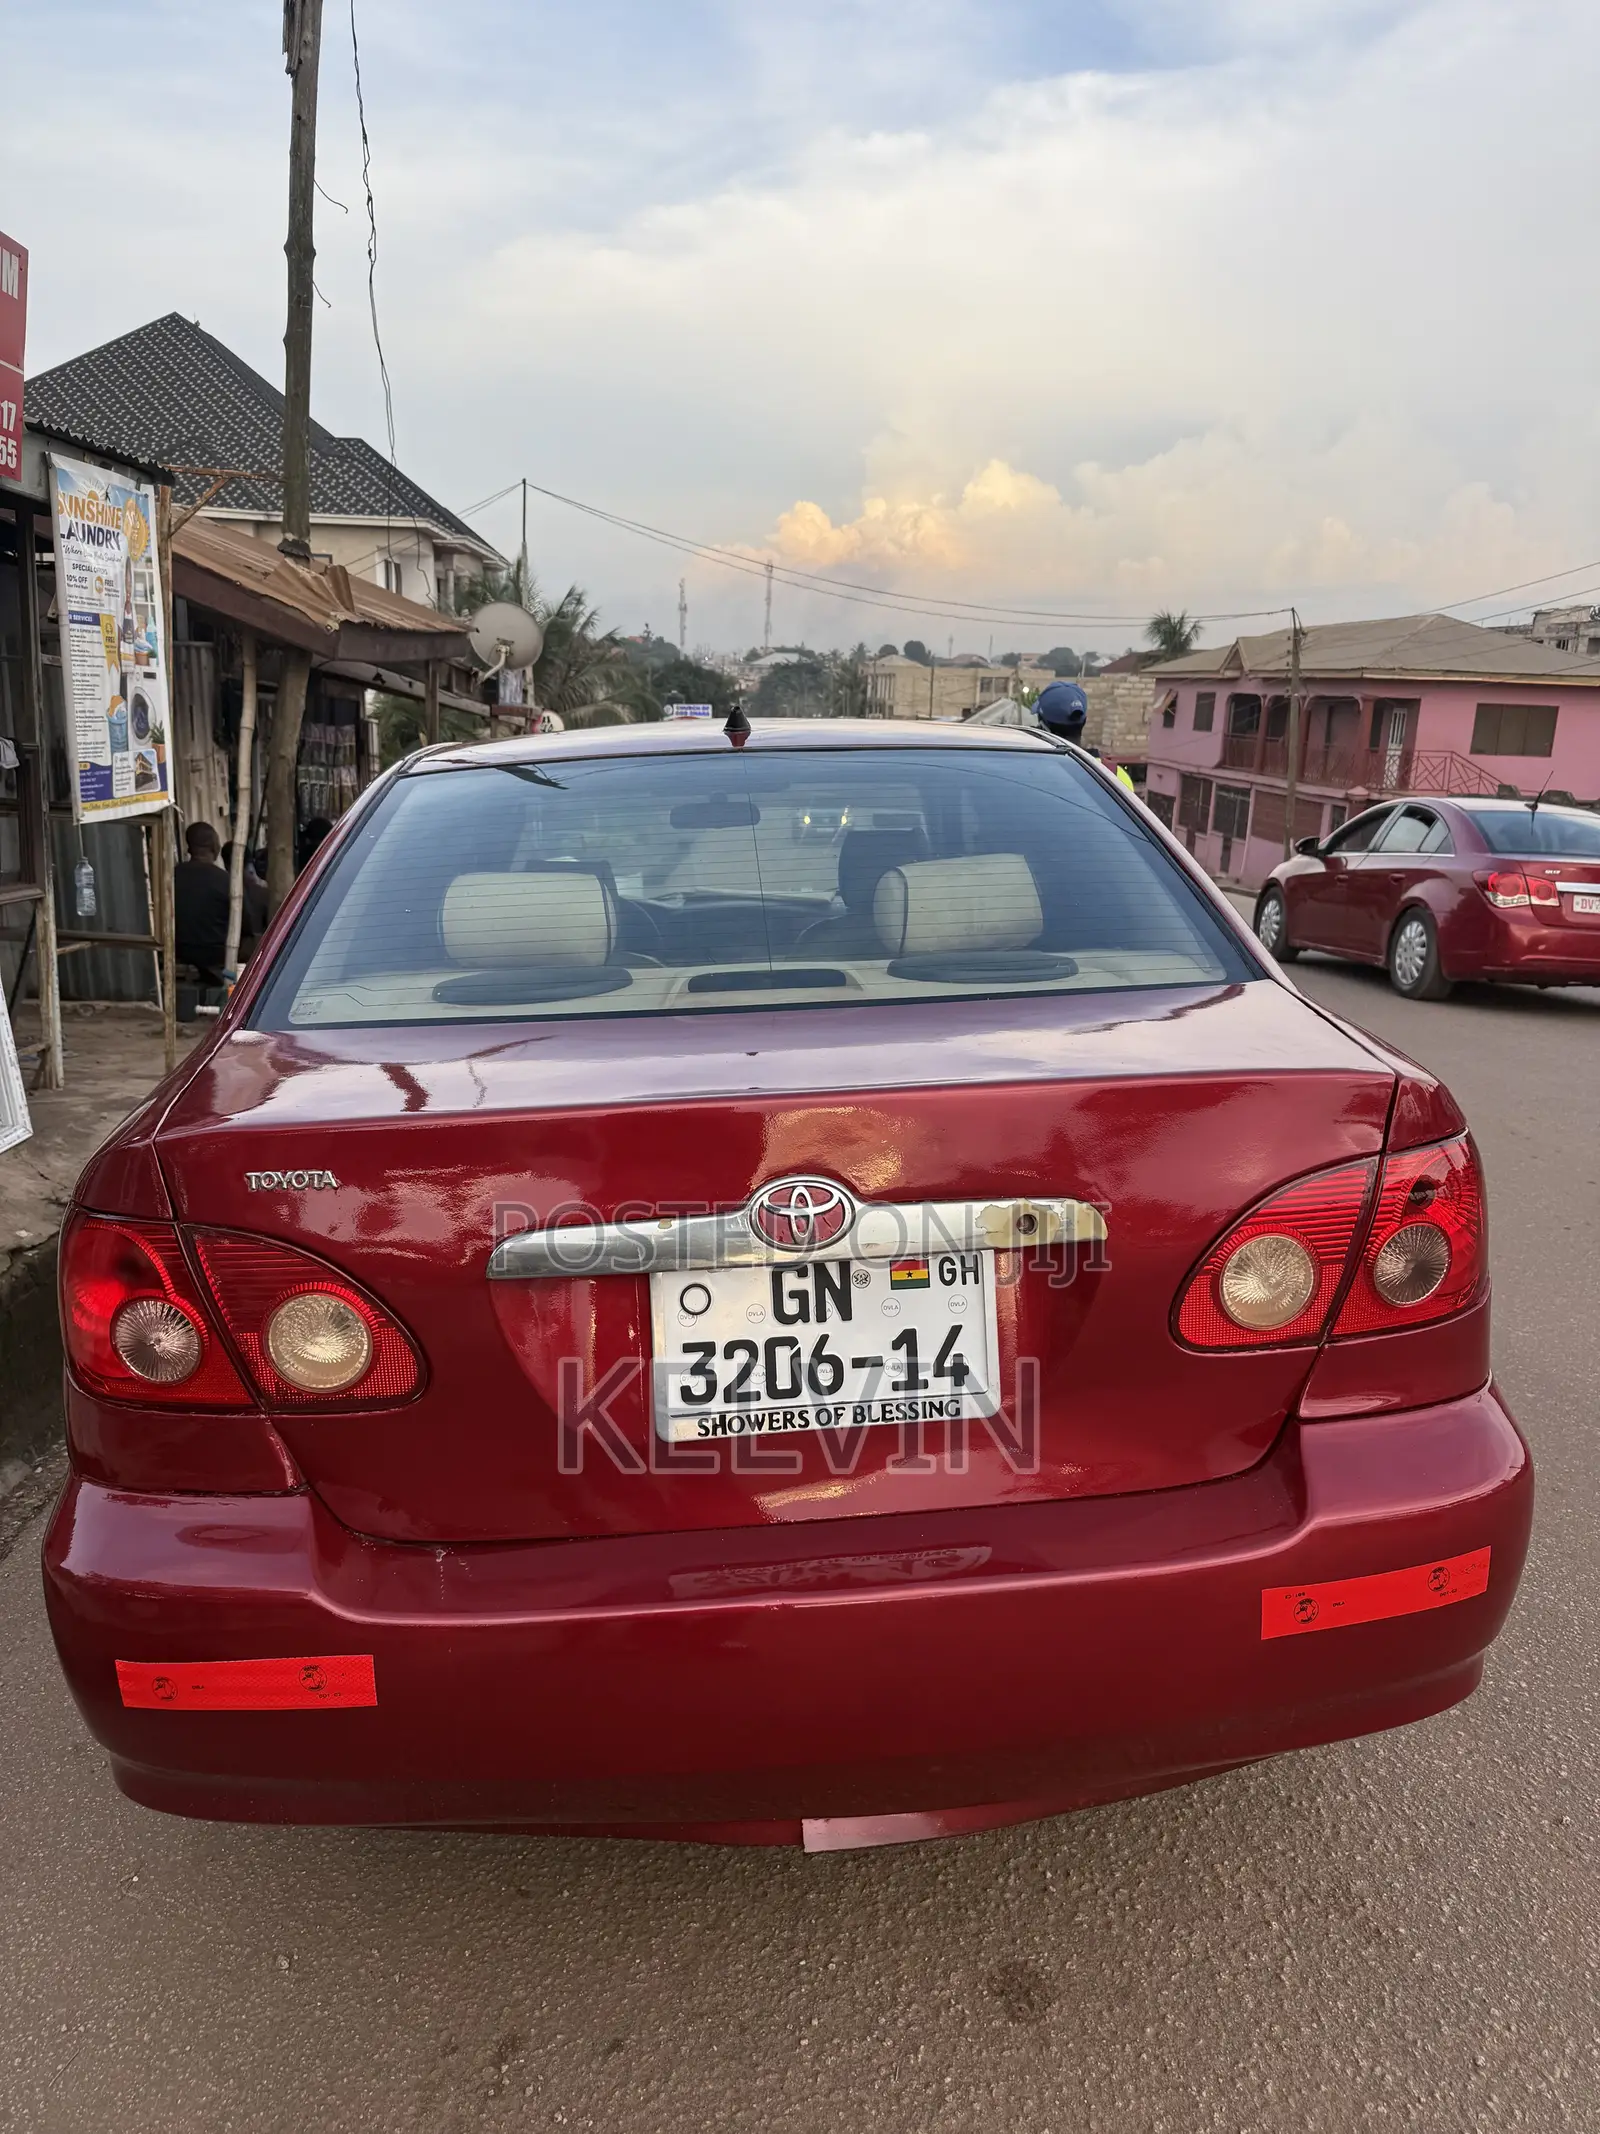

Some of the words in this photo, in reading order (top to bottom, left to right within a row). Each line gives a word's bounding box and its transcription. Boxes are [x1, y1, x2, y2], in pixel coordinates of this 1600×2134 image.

[0, 247, 19, 300] M
[0, 400, 17, 432] 17
[58, 492, 122, 530] SUNSHINE
[72, 562, 94, 573] SPECIAL
[78, 575, 88, 584] OFF
[244, 1169, 340, 1191] TOYOTA
[938, 1253, 980, 1287] GH
[771, 1260, 853, 1325] GN
[680, 1324, 970, 1406] 3206-14
[697, 1409, 810, 1438] SHOWERS
[814, 1406, 846, 1427] OF
[851, 1398, 961, 1425] BLESSING
